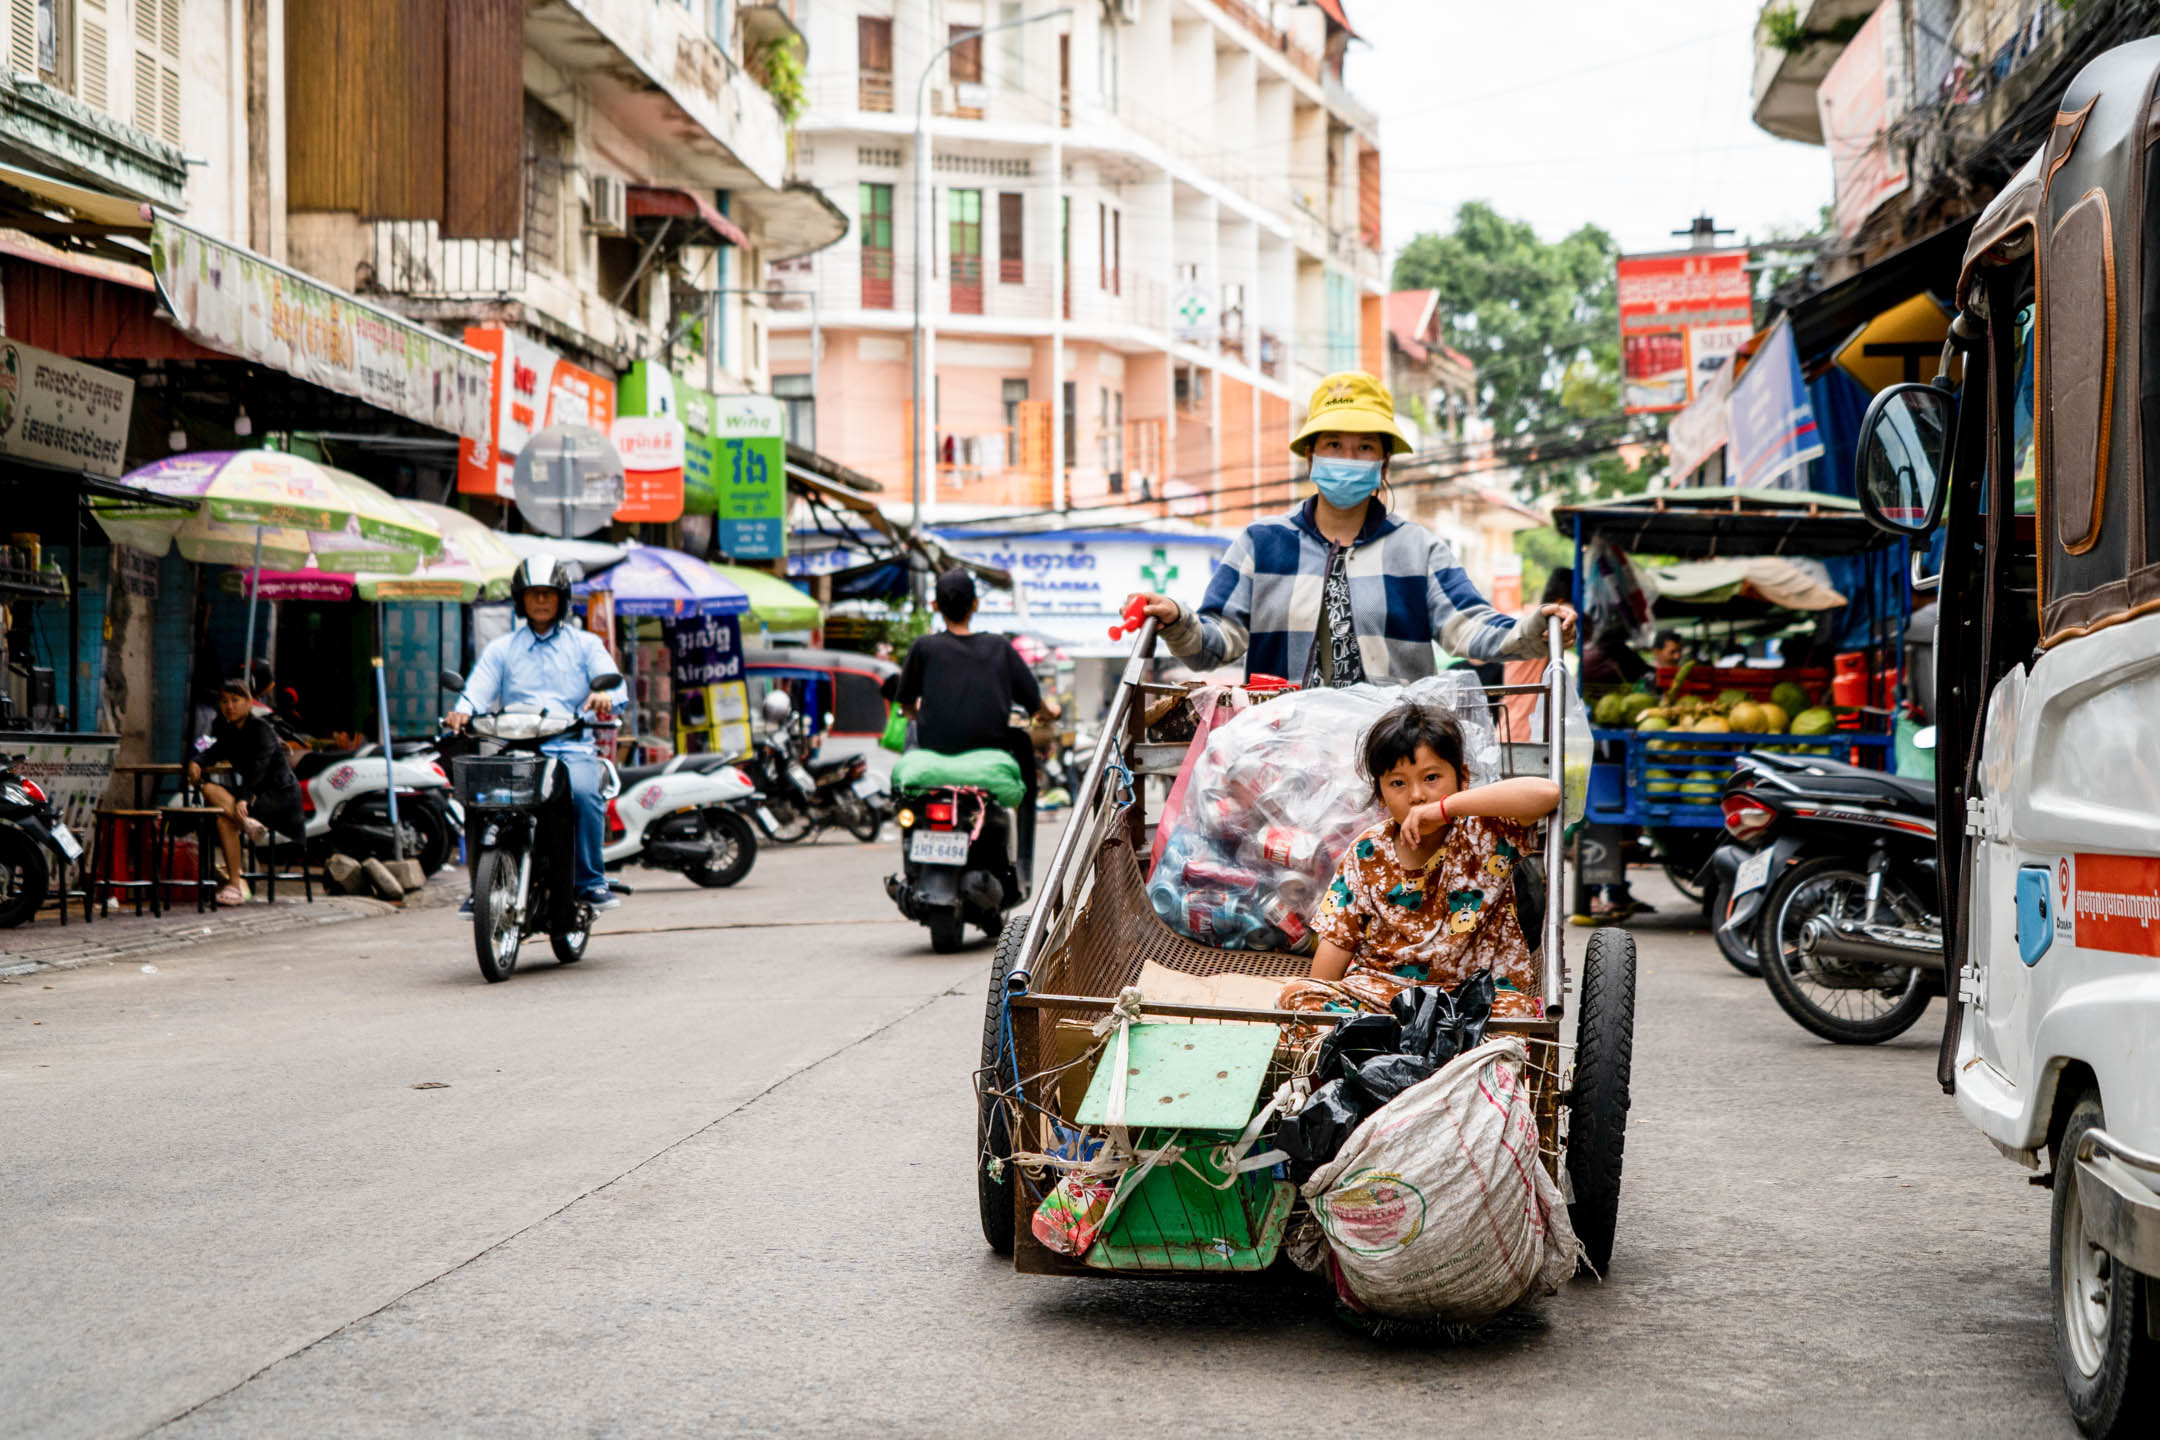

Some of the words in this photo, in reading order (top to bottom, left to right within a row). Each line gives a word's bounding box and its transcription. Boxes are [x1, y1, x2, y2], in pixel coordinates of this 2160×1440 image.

[1324, 397, 1355, 407] adidas
[726, 415, 771, 431] Wing
[677, 655, 740, 683] Airpod
